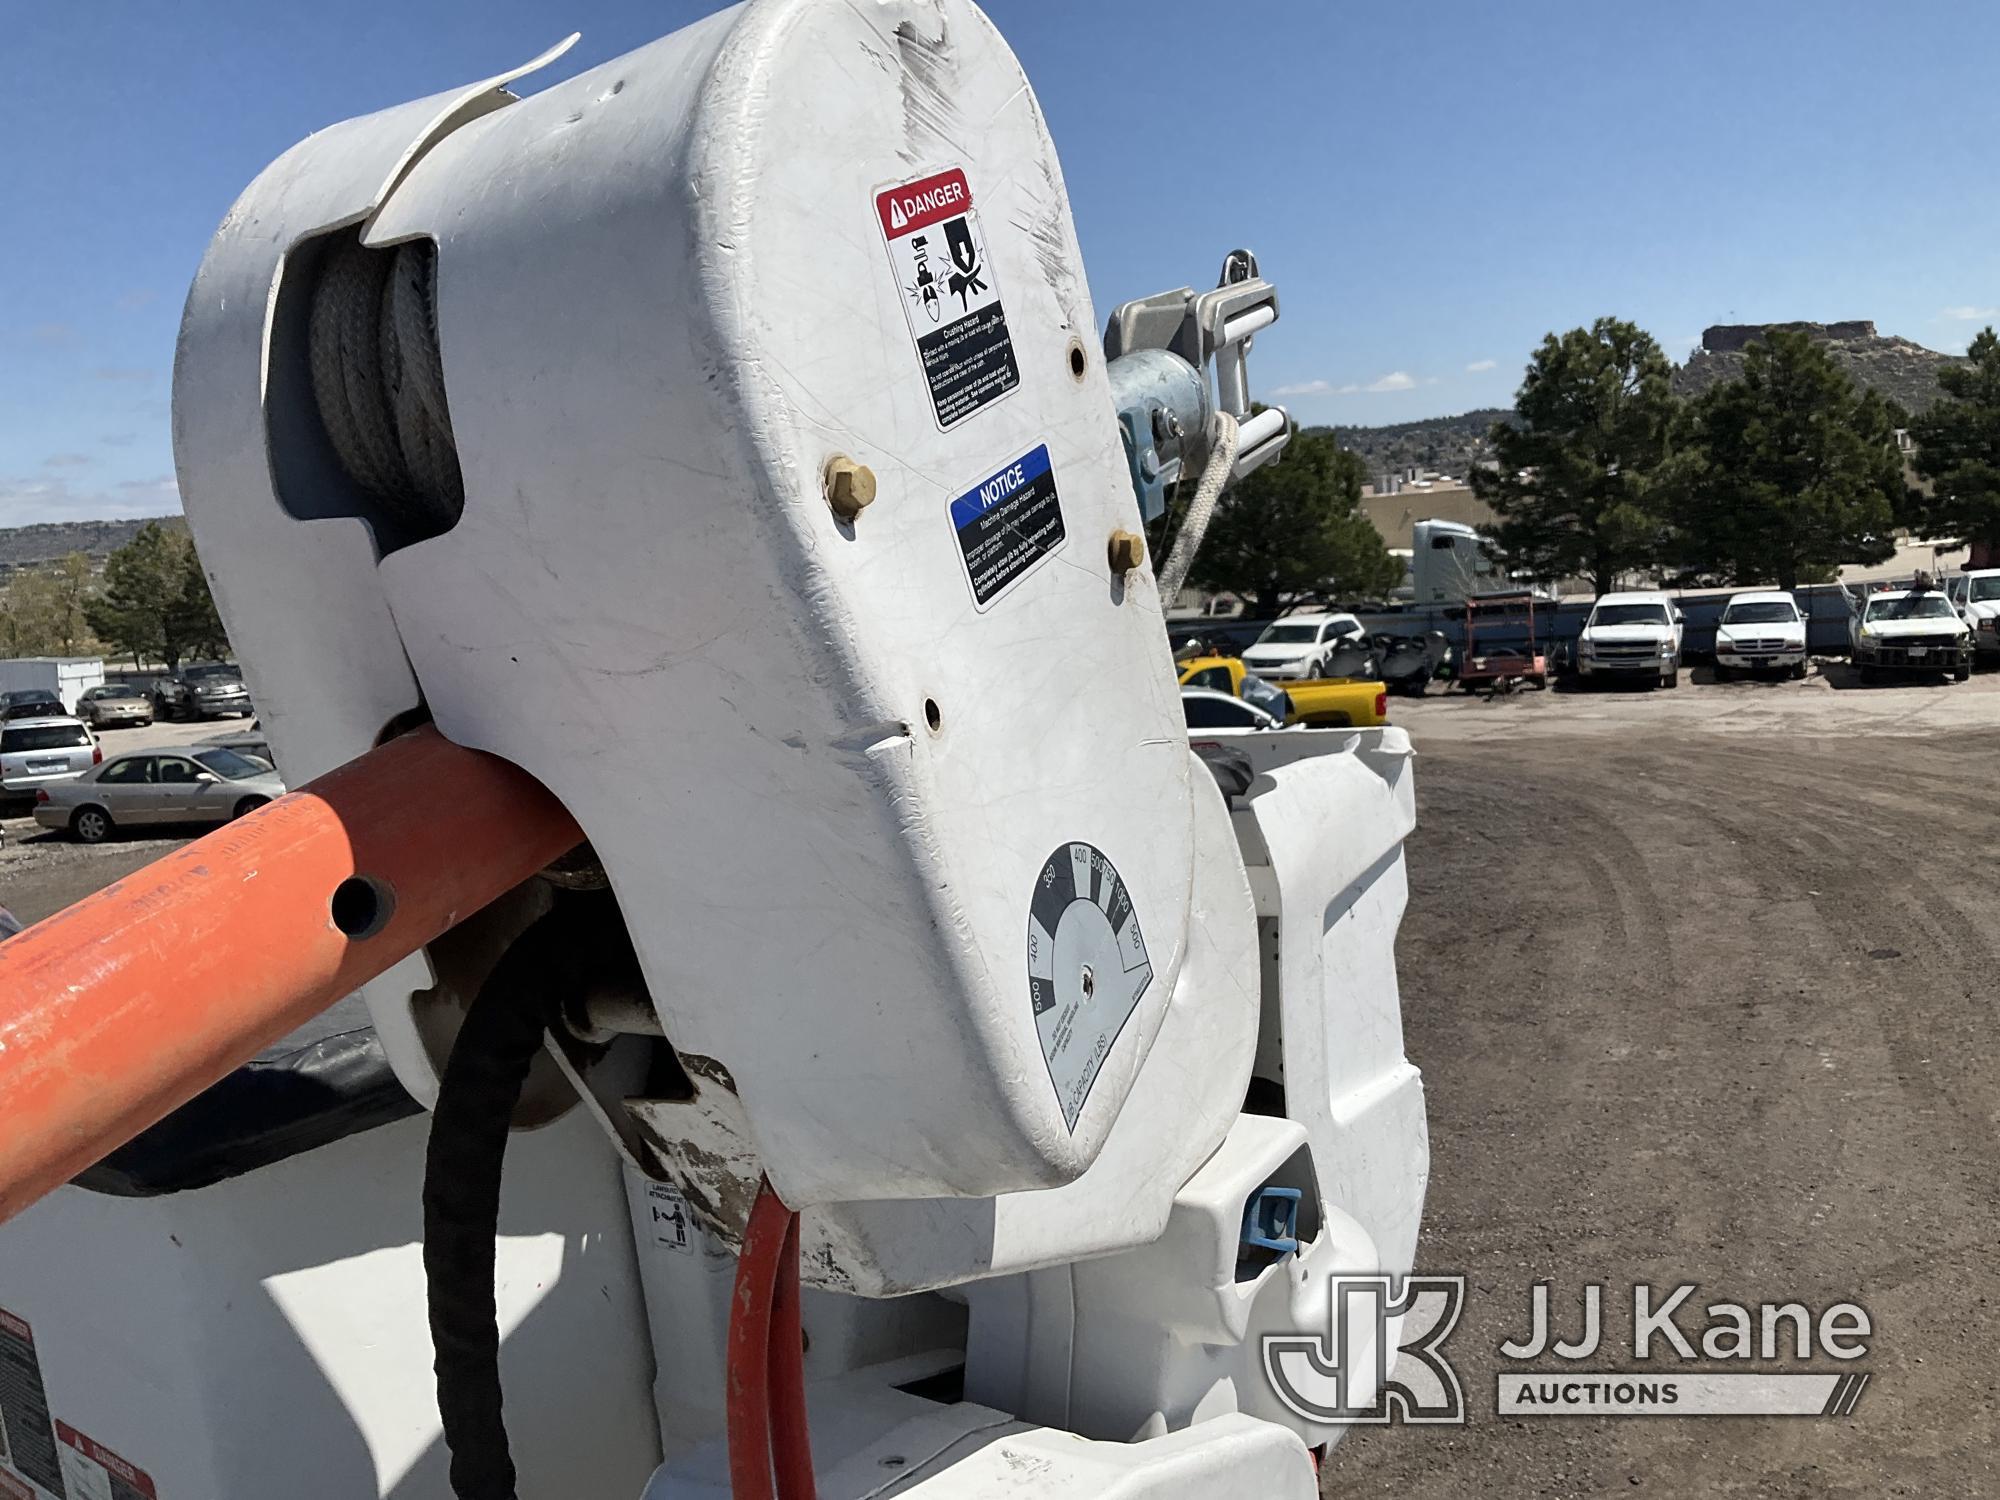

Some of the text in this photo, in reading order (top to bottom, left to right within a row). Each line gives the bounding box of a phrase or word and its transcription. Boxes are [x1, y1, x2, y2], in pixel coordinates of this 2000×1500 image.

[904, 182, 964, 218] DANGER
[943, 315, 979, 338] Crushing Hazard
[988, 342, 1002, 353] personnel
[933, 377, 953, 391] obstructions
[937, 398, 947, 407] Keep
[947, 388, 964, 402] personnel
[964, 384, 973, 392] clear
[939, 403, 955, 415] handling
[942, 411, 958, 423] complete
[980, 464, 1024, 507] NOTICE
[980, 487, 1035, 529] Machine Damage Hazard
[966, 543, 983, 560] Improper
[984, 531, 1001, 547] stowage
[974, 565, 997, 585] Completely
[997, 557, 1007, 568] stow
[977, 577, 996, 596] cylinders
[996, 567, 1009, 580] before
[1009, 555, 1025, 570] stowing
[1074, 848, 1087, 863] 400
[1091, 853, 1103, 873] 500
[1044, 864, 1056, 888] 350
[1102, 861, 1116, 886] 750
[1115, 882, 1130, 912] 1000
[1030, 934, 1038, 962] 400
[1130, 924, 1140, 949] 500
[1032, 982, 1042, 1011] 500
[1073, 1056, 1095, 1105] CAPACITY
[1094, 1032, 1107, 1061] (LBS)
